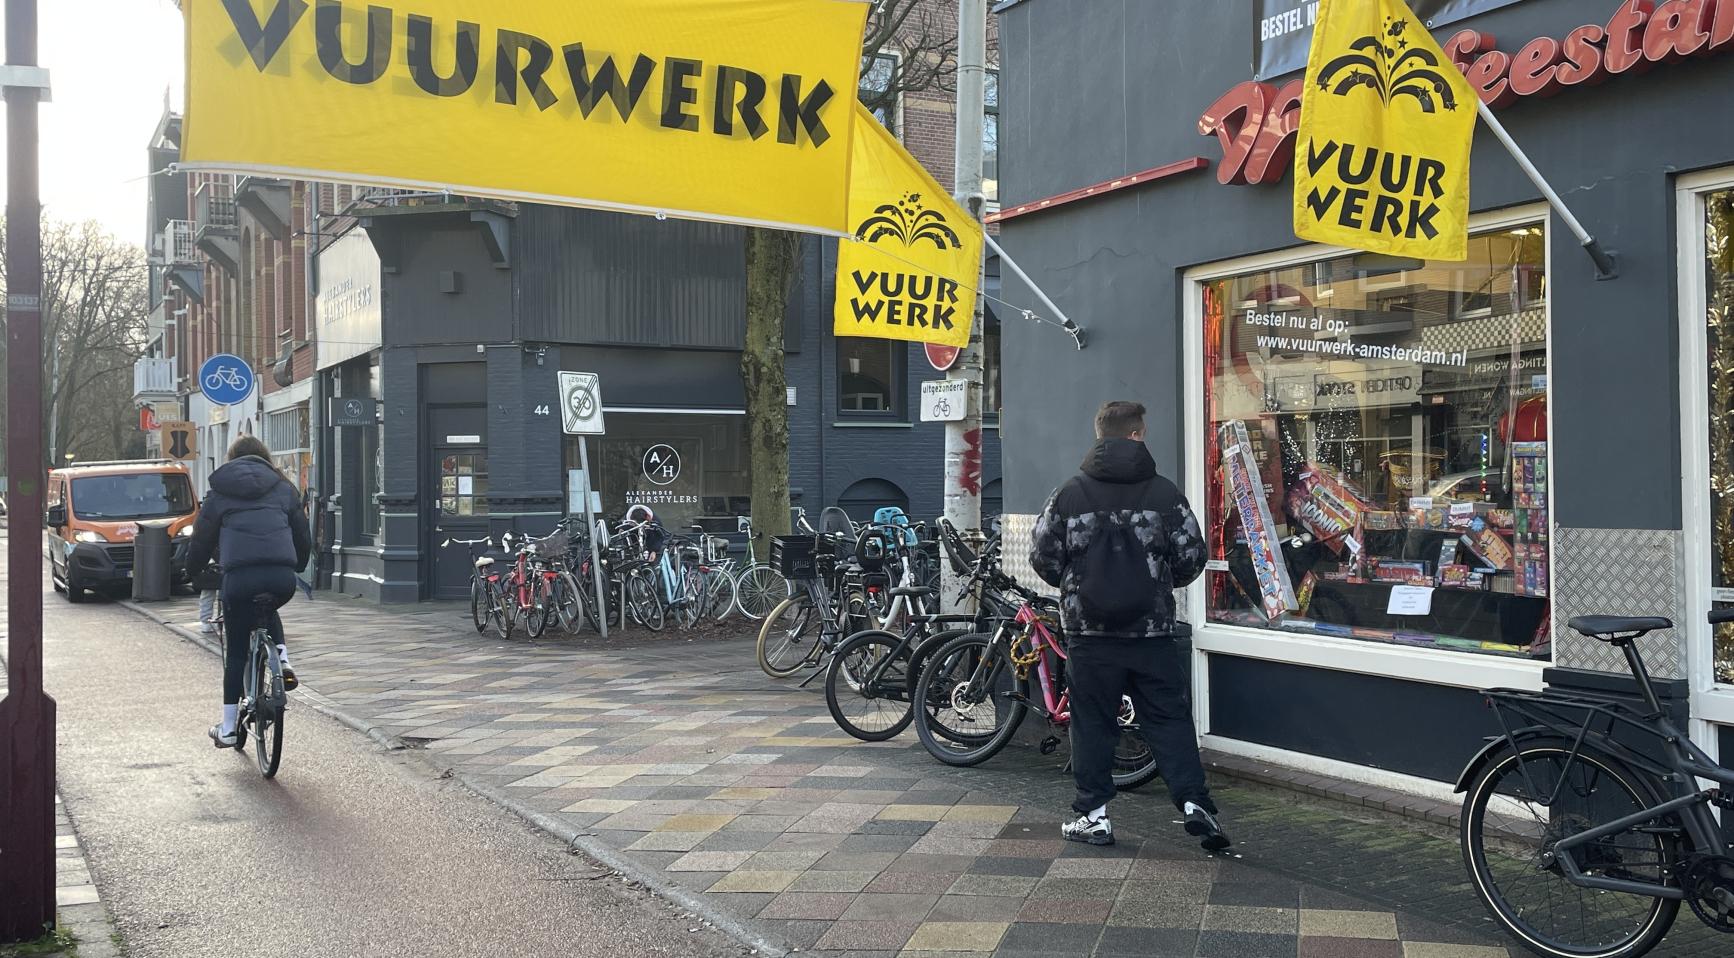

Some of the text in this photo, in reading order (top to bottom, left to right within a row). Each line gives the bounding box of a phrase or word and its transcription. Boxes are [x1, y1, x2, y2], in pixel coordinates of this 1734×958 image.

[1261, 8, 1304, 41] BESTEL
[220, 0, 836, 149] VUURWERK
[1307, 136, 1446, 199] VUUR
[1306, 185, 1441, 240] WERK
[851, 269, 959, 304] VUUR
[850, 297, 956, 331] WERK
[1245, 309, 1349, 336] Bestel nu al op:
[1256, 335, 1467, 366] www.vuurwerk-amsterdam.nl
[571, 376, 588, 384] ZONE
[922, 383, 964, 395] uitgezonderd
[534, 404, 550, 415] 44
[625, 495, 698, 504] HAIRSTYLERS
[1301, 500, 1342, 533] ICONIC
